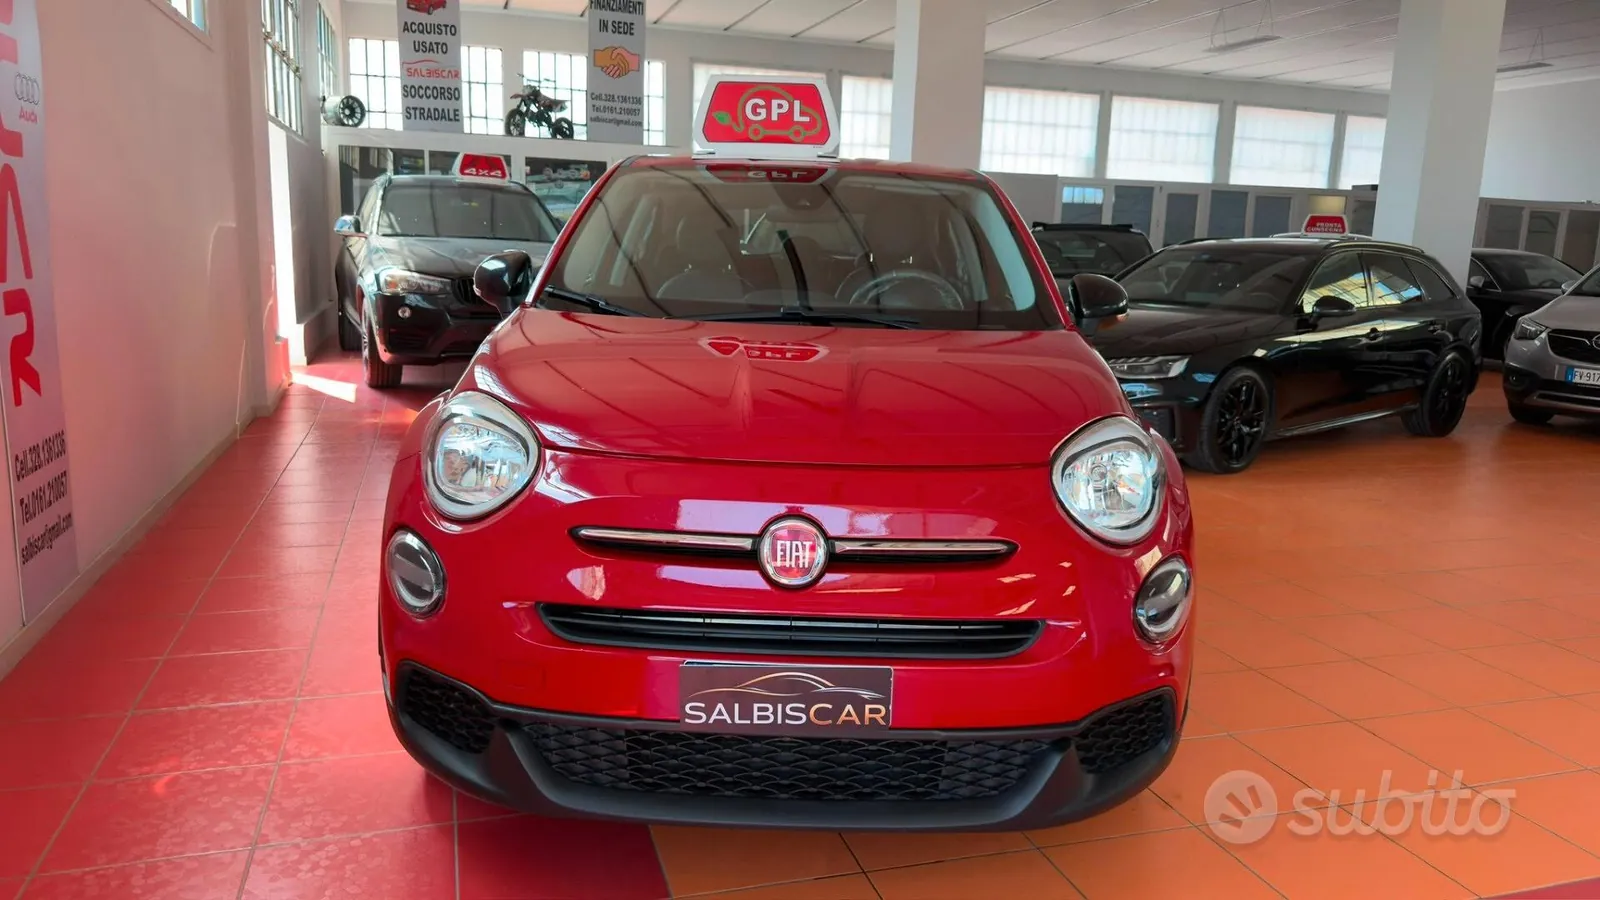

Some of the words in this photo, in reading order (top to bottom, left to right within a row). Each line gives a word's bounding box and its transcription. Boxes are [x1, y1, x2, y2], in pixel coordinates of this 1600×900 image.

[590, 0, 644, 15] FINANZIAMENTI
[402, 21, 457, 36] ACQUISTO
[599, 18, 609, 33] IN
[611, 20, 635, 36] SEDE
[413, 40, 448, 54] USATO
[402, 84, 461, 101] SOCCORSO
[19, 106, 38, 123] Audi
[405, 106, 460, 122] STRADALE
[745, 98, 810, 122] GPL
[775, 540, 812, 569] FIAT
[684, 702, 887, 726] SALBISCAR
